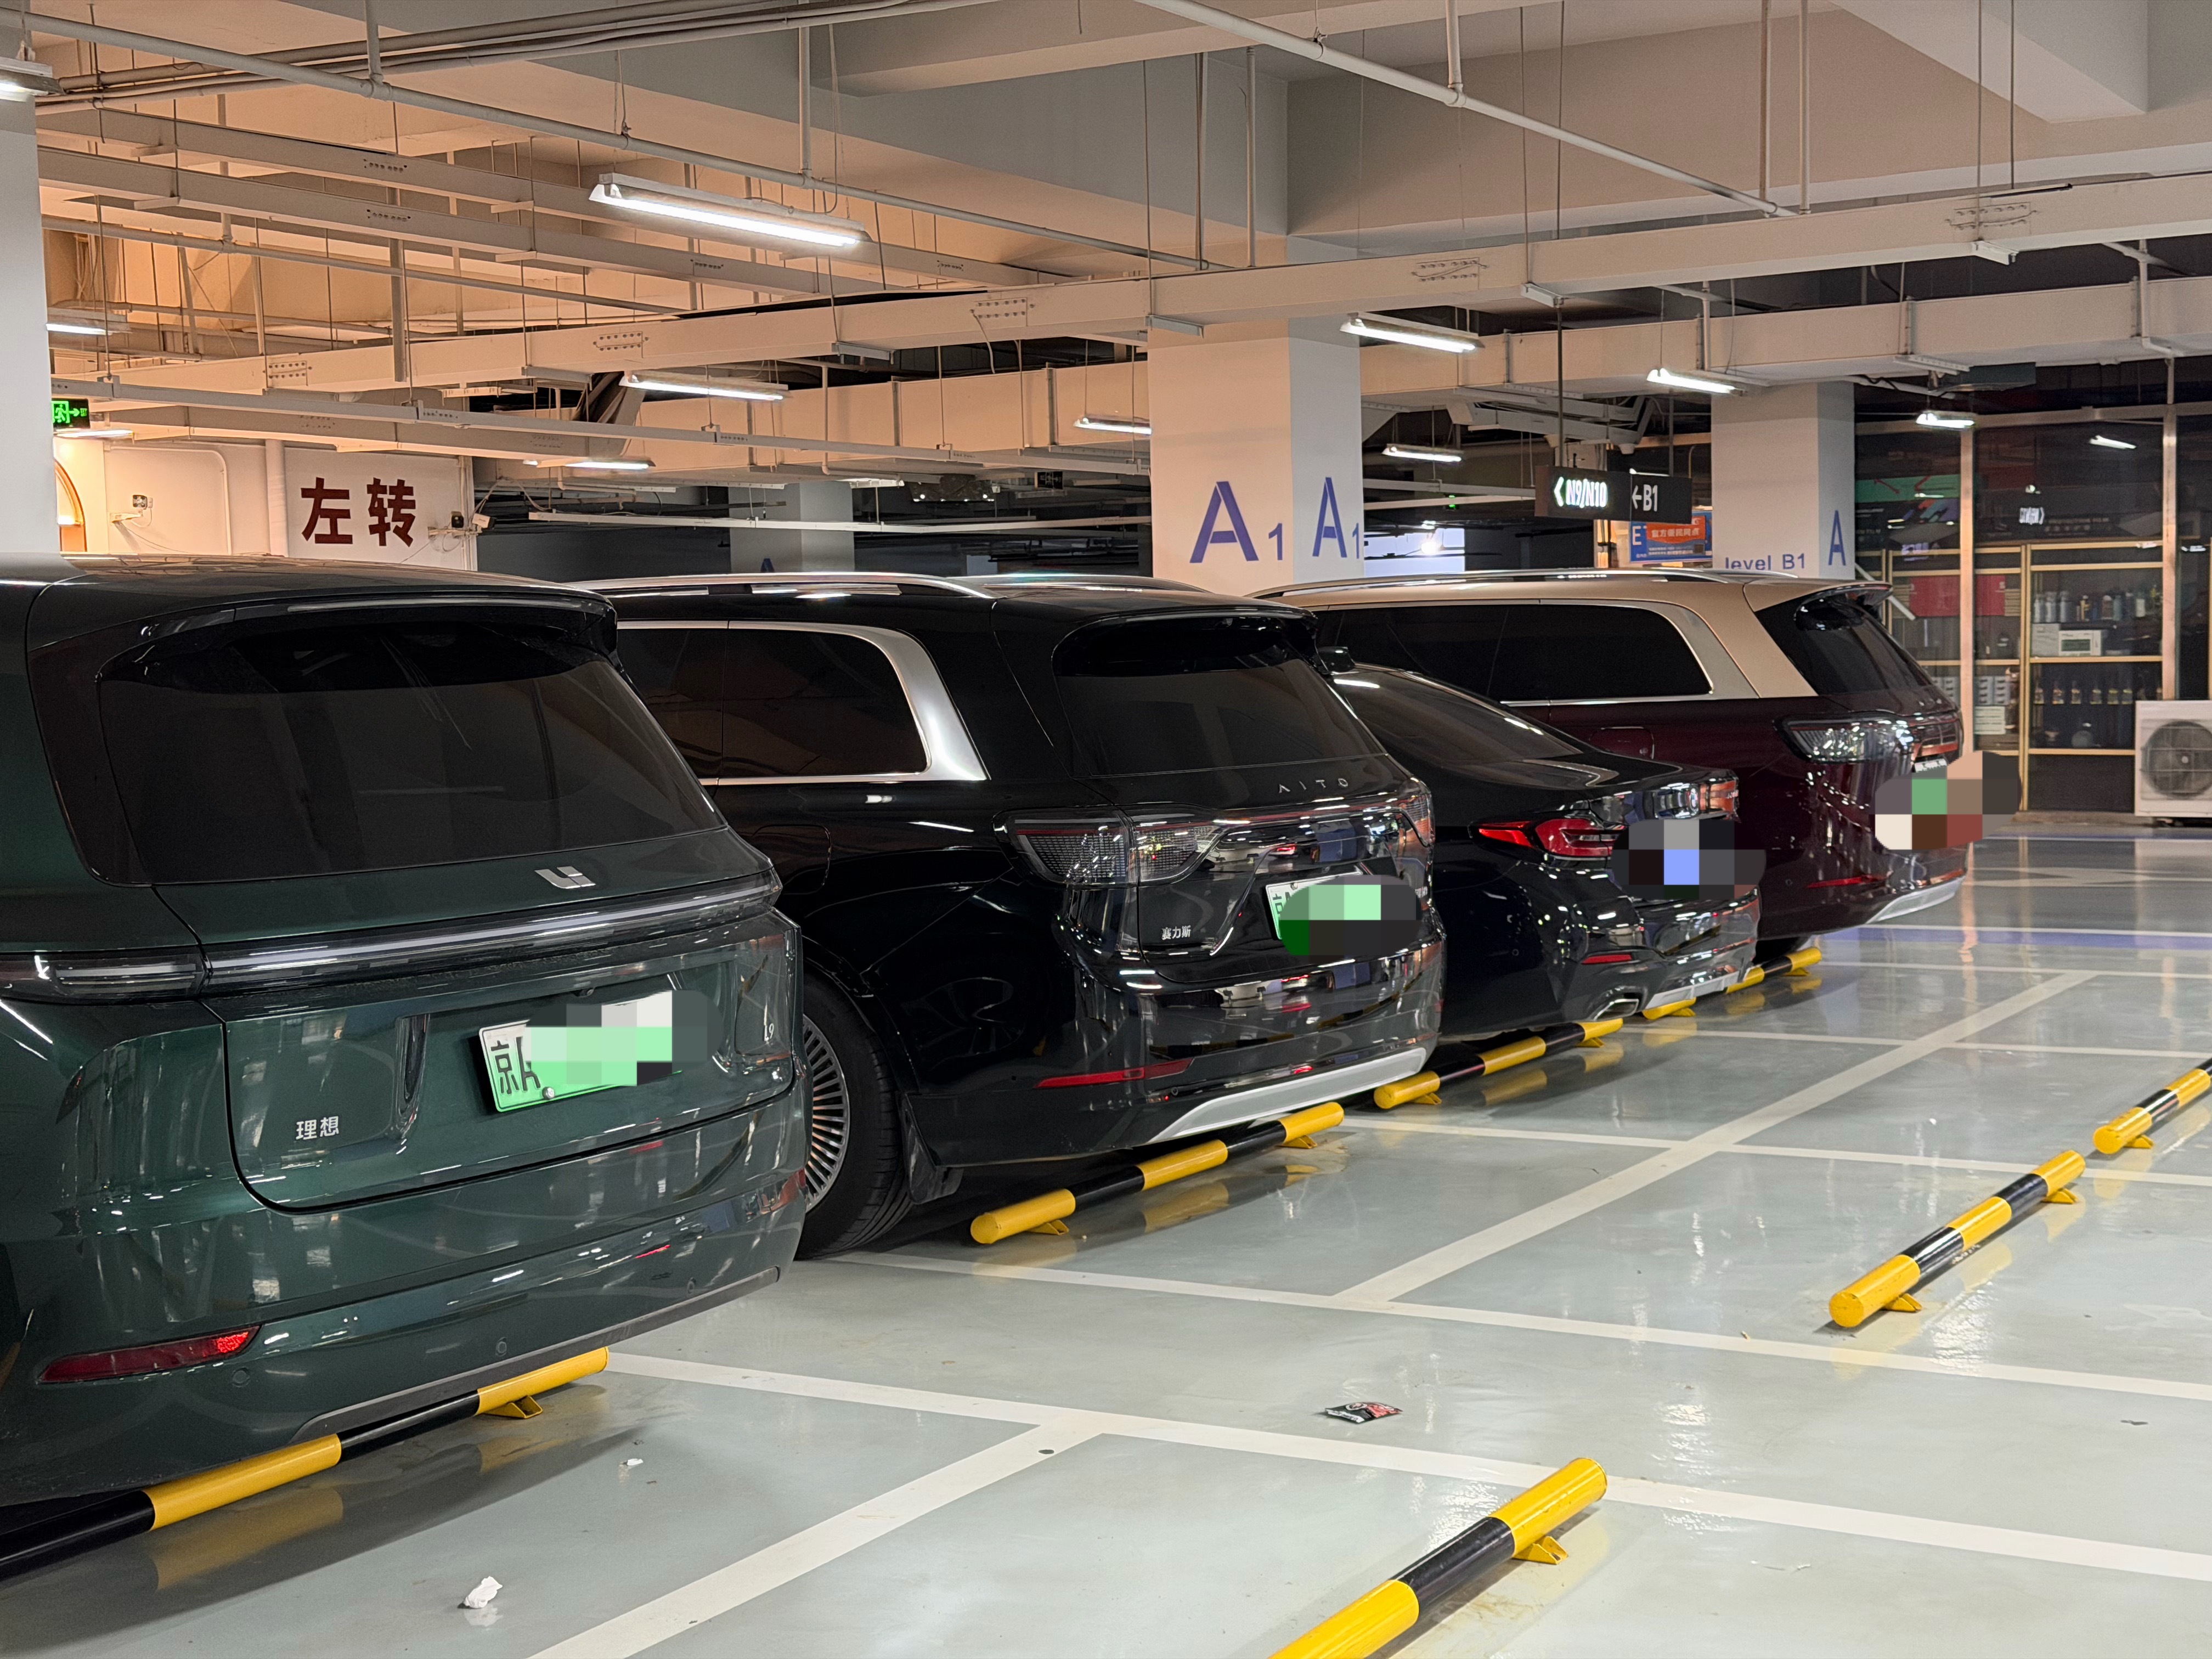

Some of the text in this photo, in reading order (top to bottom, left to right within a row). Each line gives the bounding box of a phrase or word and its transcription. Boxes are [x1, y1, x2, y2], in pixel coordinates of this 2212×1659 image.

[1566, 478, 1608, 509] N9/N10
[1643, 484, 1658, 512] B1
[301, 477, 416, 548] 左转
[1828, 510, 1847, 567] A
[1725, 553, 1805, 571] level B1
[1278, 777, 1348, 794] AITO
[1161, 924, 1192, 940] 赛力斯
[764, 1023, 774, 1041] L9
[295, 1115, 340, 1141] 理想
